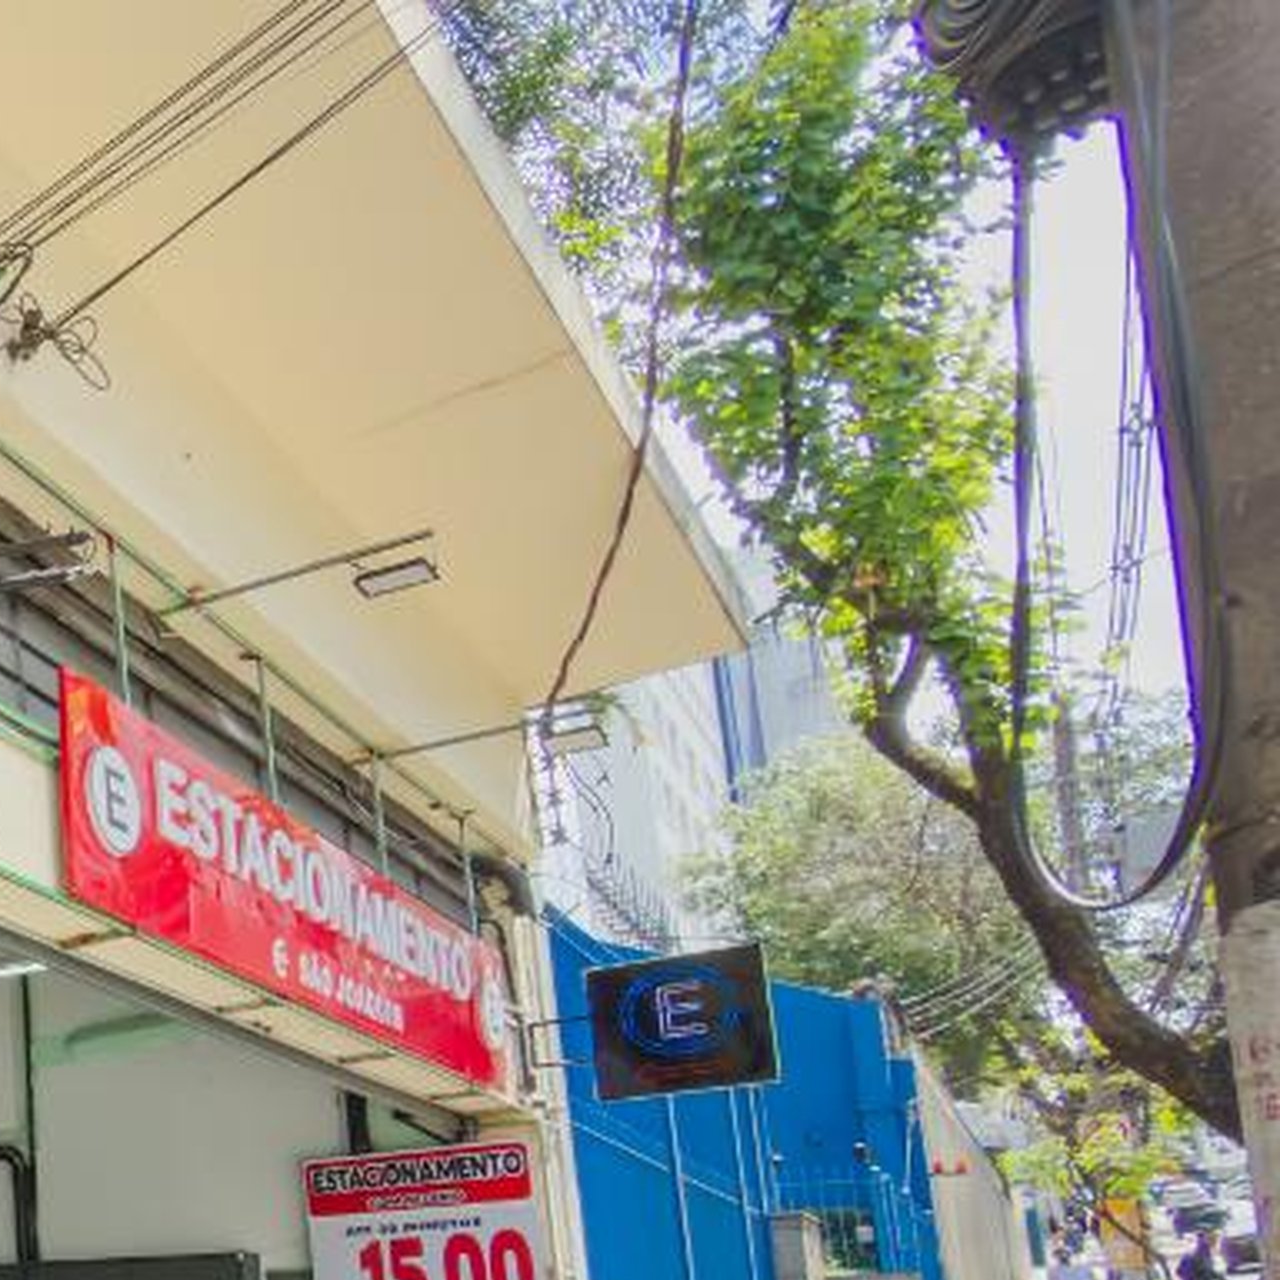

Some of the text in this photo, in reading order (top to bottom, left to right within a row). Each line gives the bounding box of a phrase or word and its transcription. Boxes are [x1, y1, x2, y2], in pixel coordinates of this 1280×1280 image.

[153, 758, 472, 1001] ESTACIONAMENTO
[655, 980, 710, 1041] E
[312, 1152, 522, 1194] ESTACIONAMENTO
